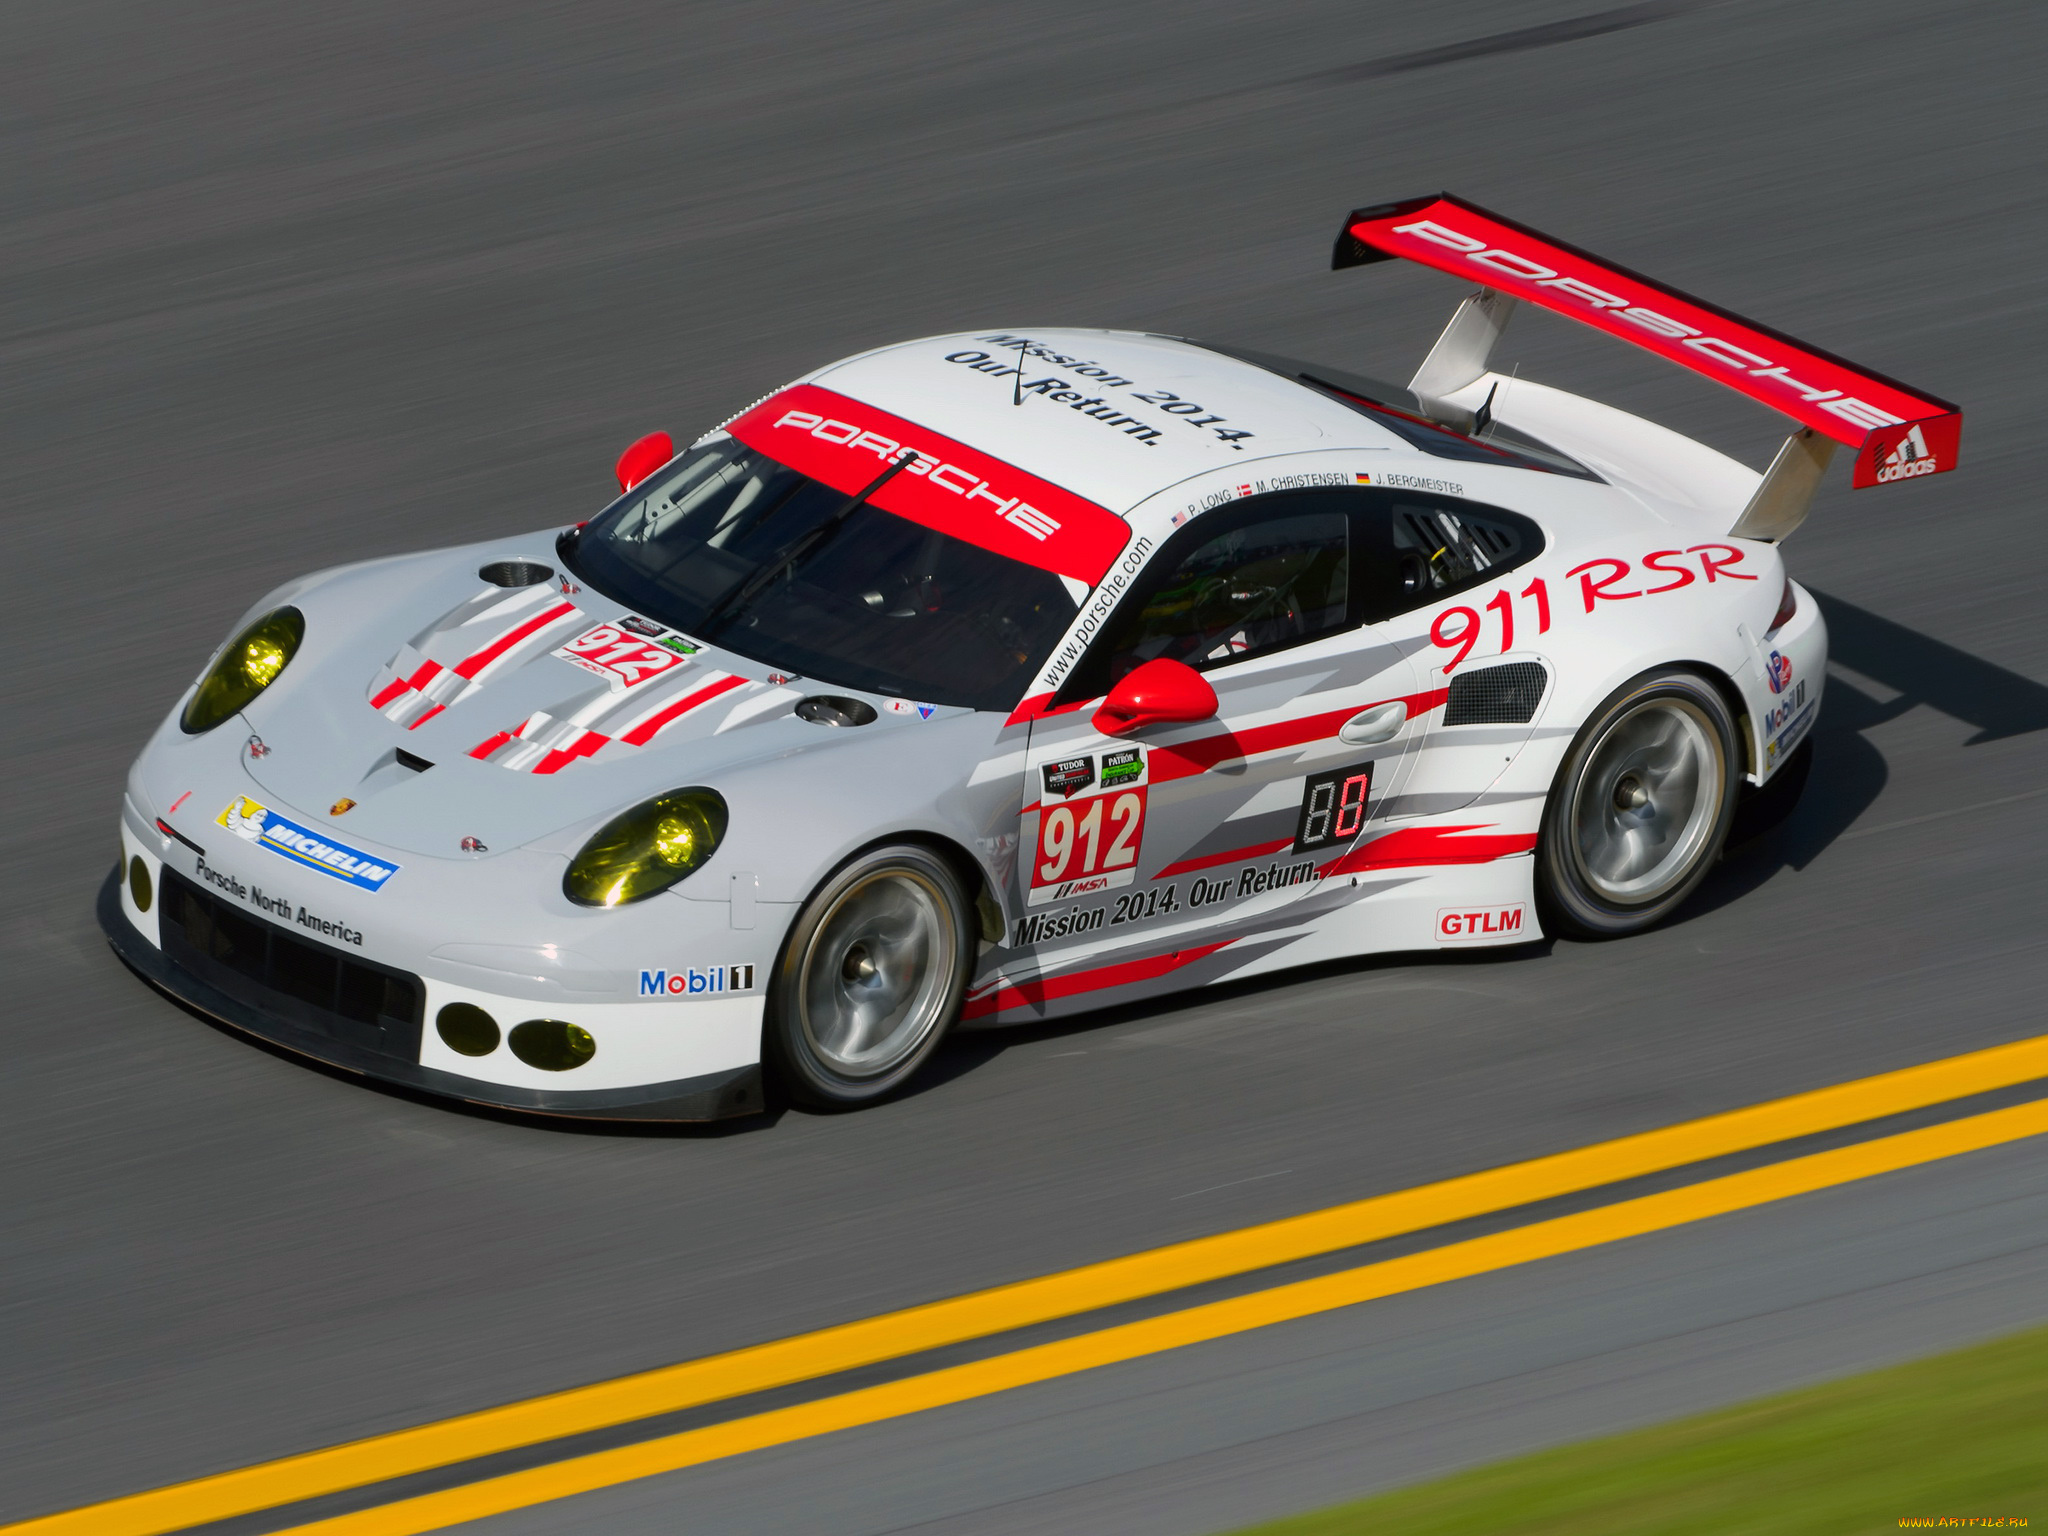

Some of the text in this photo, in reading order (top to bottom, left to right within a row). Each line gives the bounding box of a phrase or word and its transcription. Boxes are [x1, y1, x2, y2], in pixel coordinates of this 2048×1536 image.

[1393, 219, 1908, 430] PORSCHE
[944, 350, 1162, 447] Our Return.
[975, 334, 1255, 450] Mission 2014.
[773, 409, 1062, 542] PORSCHE
[1256, 472, 1350, 494] M. CHRISTENSEN
[1375, 473, 1465, 495] J. BERGMEISTER
[1877, 458, 1937, 482] adidas
[1188, 489, 1232, 517] P. LONG
[1044, 536, 1153, 687] www.porsche.com
[1430, 543, 1759, 675] 911 RSR
[569, 628, 673, 682] 912
[1765, 688, 1796, 739] Mobil
[1058, 759, 1085, 772] TUDOR
[264, 823, 393, 882] MICHELIN
[1041, 793, 1140, 881] 912
[195, 856, 364, 946] Porsche North America
[1013, 860, 1320, 948] Mission 2014. Our Return.
[1441, 908, 1522, 935] GTLM
[641, 966, 723, 995] Mobil
